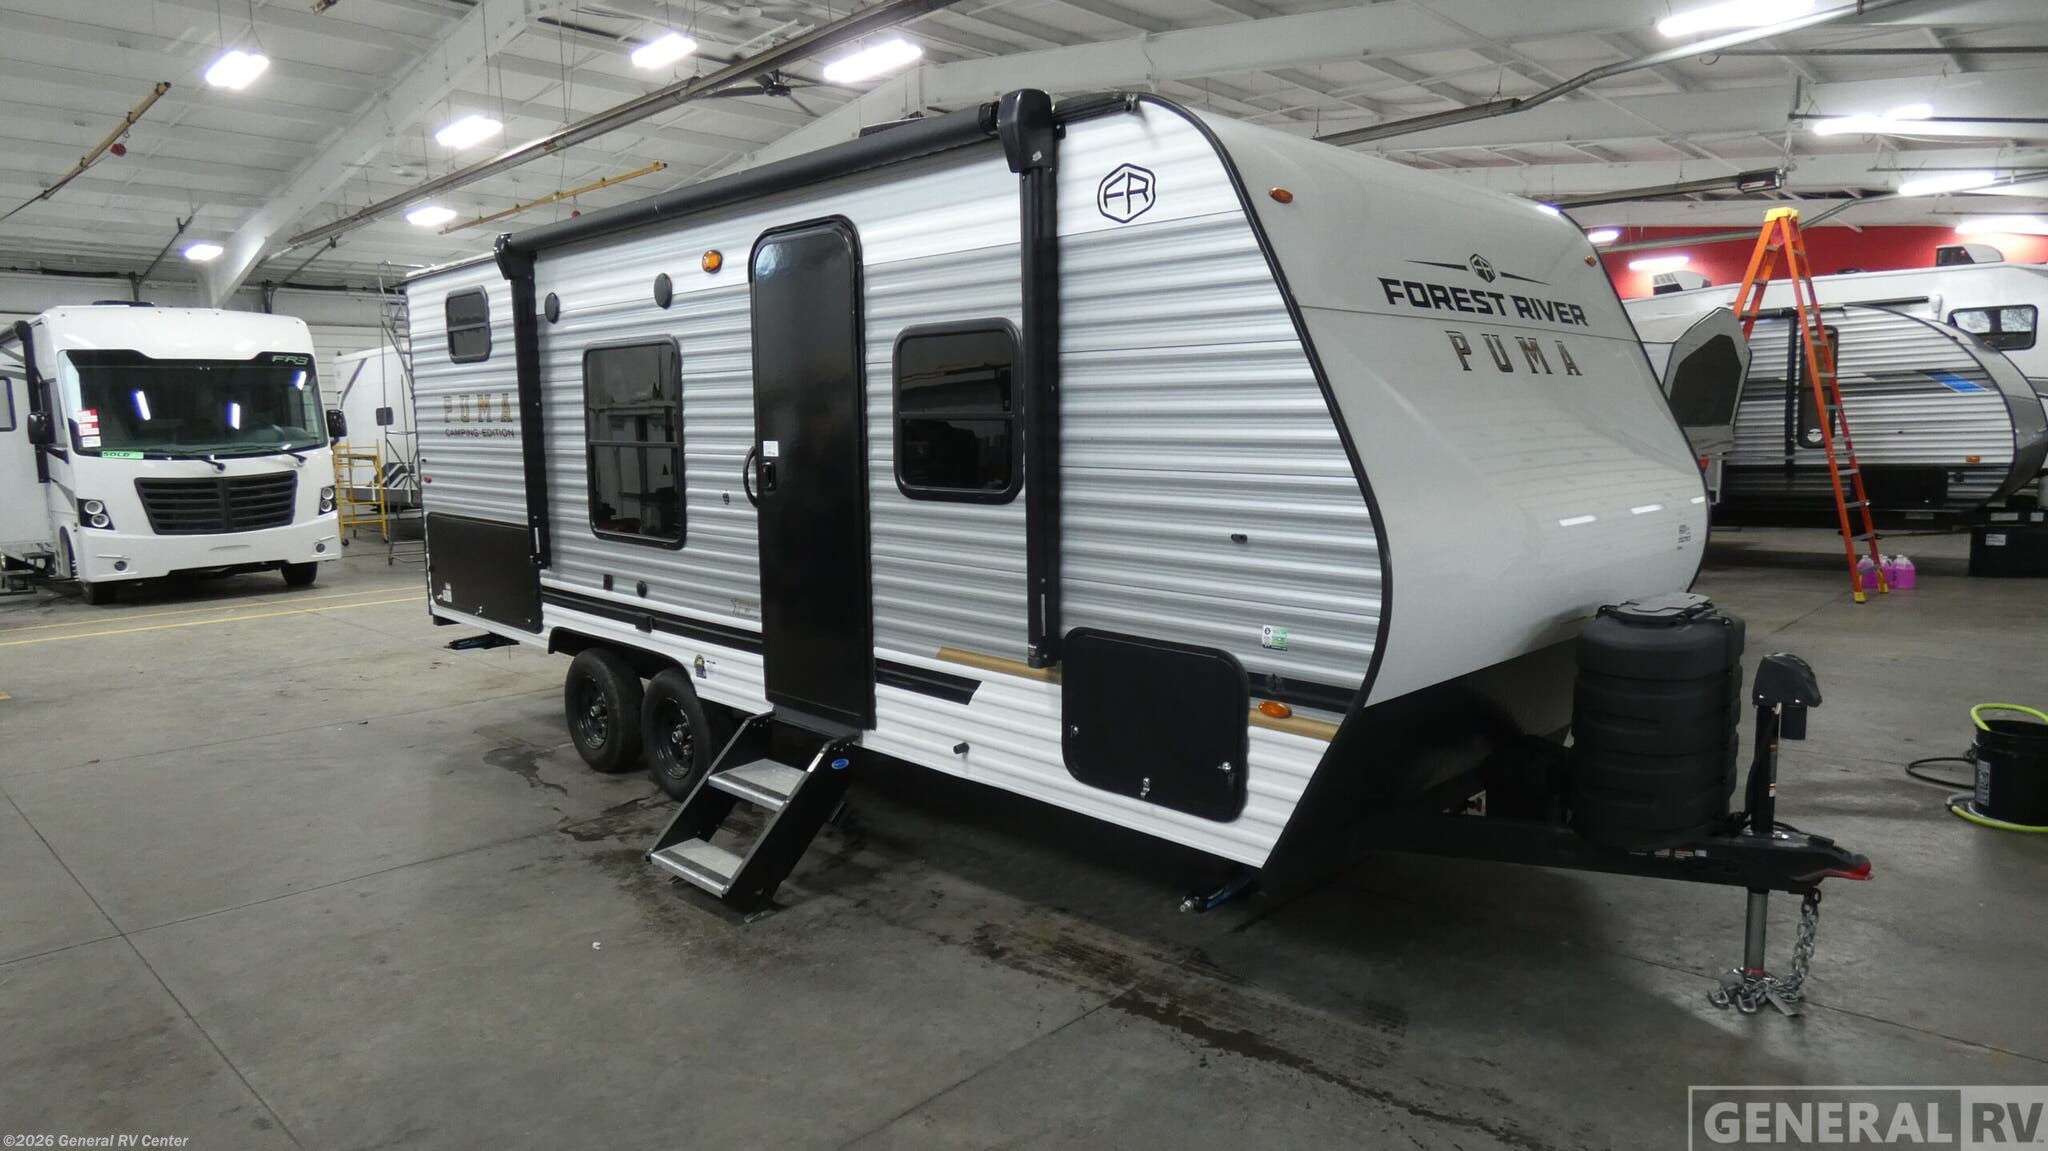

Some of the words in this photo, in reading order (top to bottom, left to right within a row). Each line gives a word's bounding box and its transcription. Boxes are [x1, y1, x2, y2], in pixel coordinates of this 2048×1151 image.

[1377, 277, 1507, 316] FOREST
[1510, 295, 1589, 327] RIVER
[272, 355, 309, 365] FR3
[1444, 330, 1583, 376] PUMA
[443, 393, 513, 423] PUMA
[445, 428, 480, 437] CAMPING
[482, 428, 515, 437] EDITION
